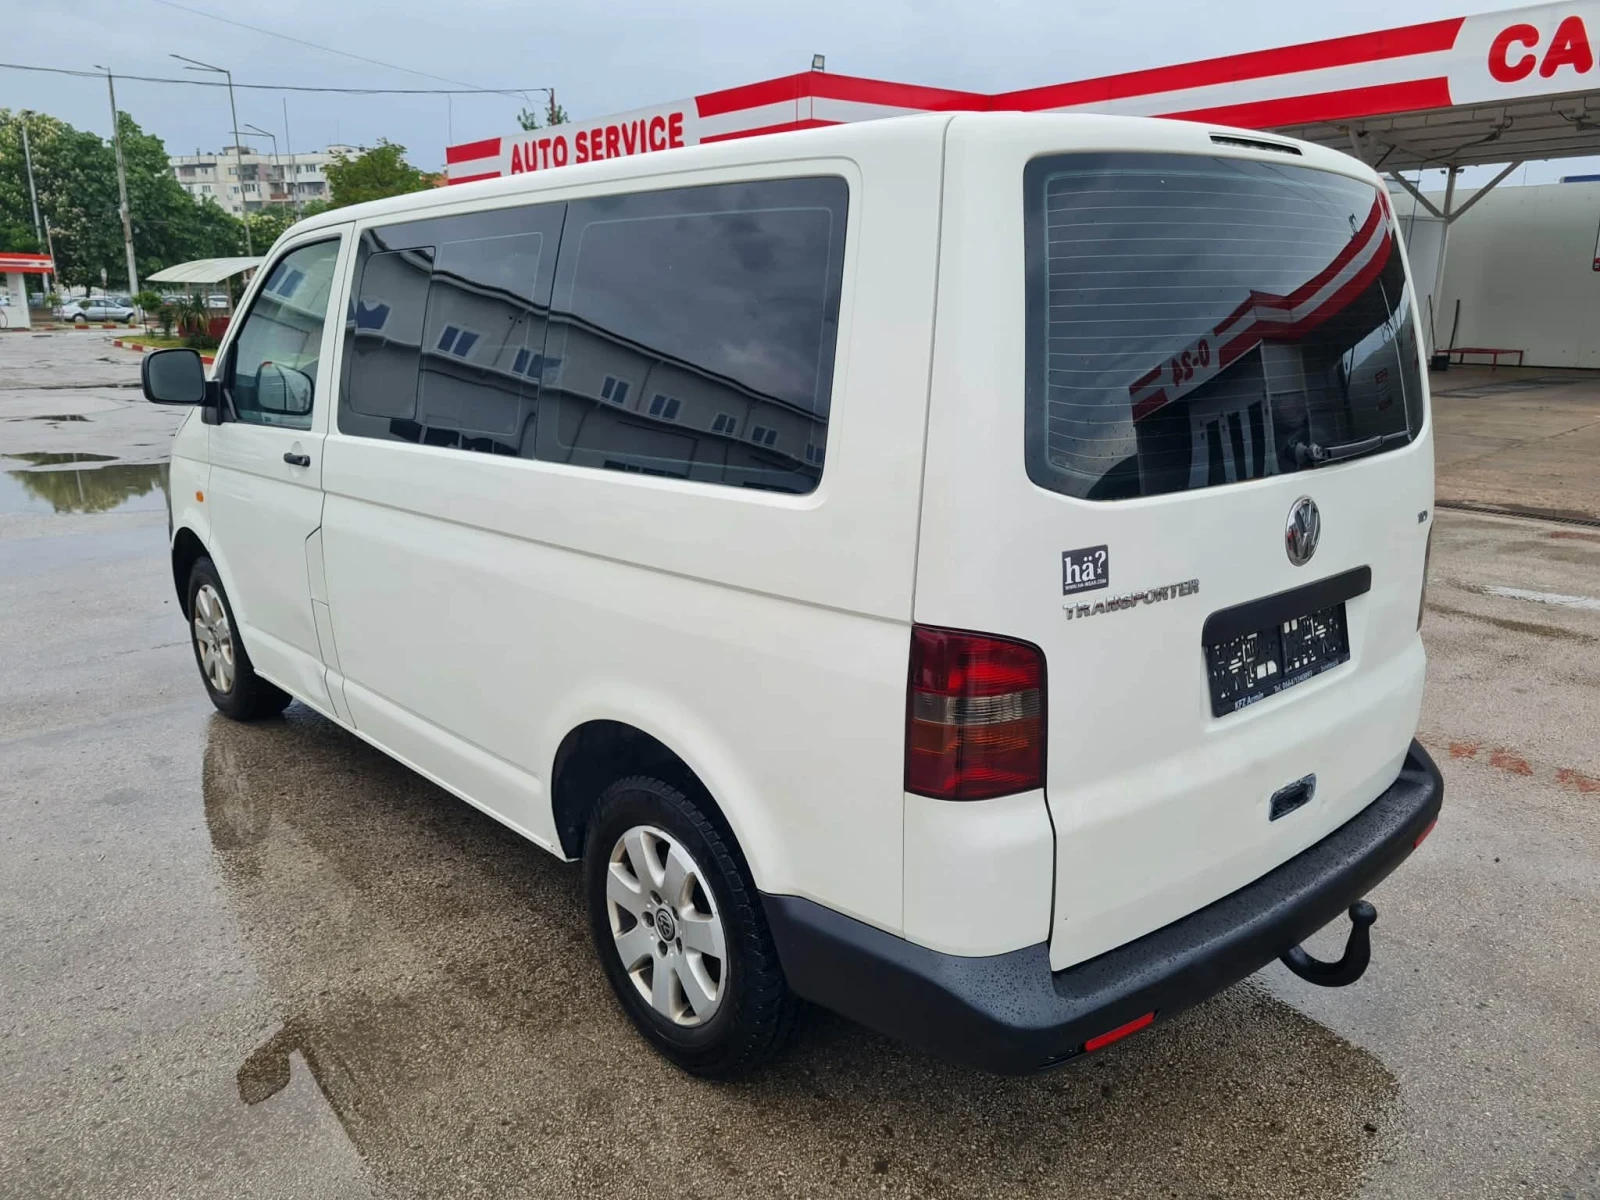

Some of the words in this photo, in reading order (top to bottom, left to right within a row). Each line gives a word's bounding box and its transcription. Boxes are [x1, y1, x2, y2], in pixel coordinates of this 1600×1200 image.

[1488, 15, 1600, 83] CA
[511, 135, 568, 175] AUTO
[575, 112, 685, 164] SERVICE
[1064, 550, 1106, 584] hä?
[1063, 579, 1199, 620] TRANSPORTER
